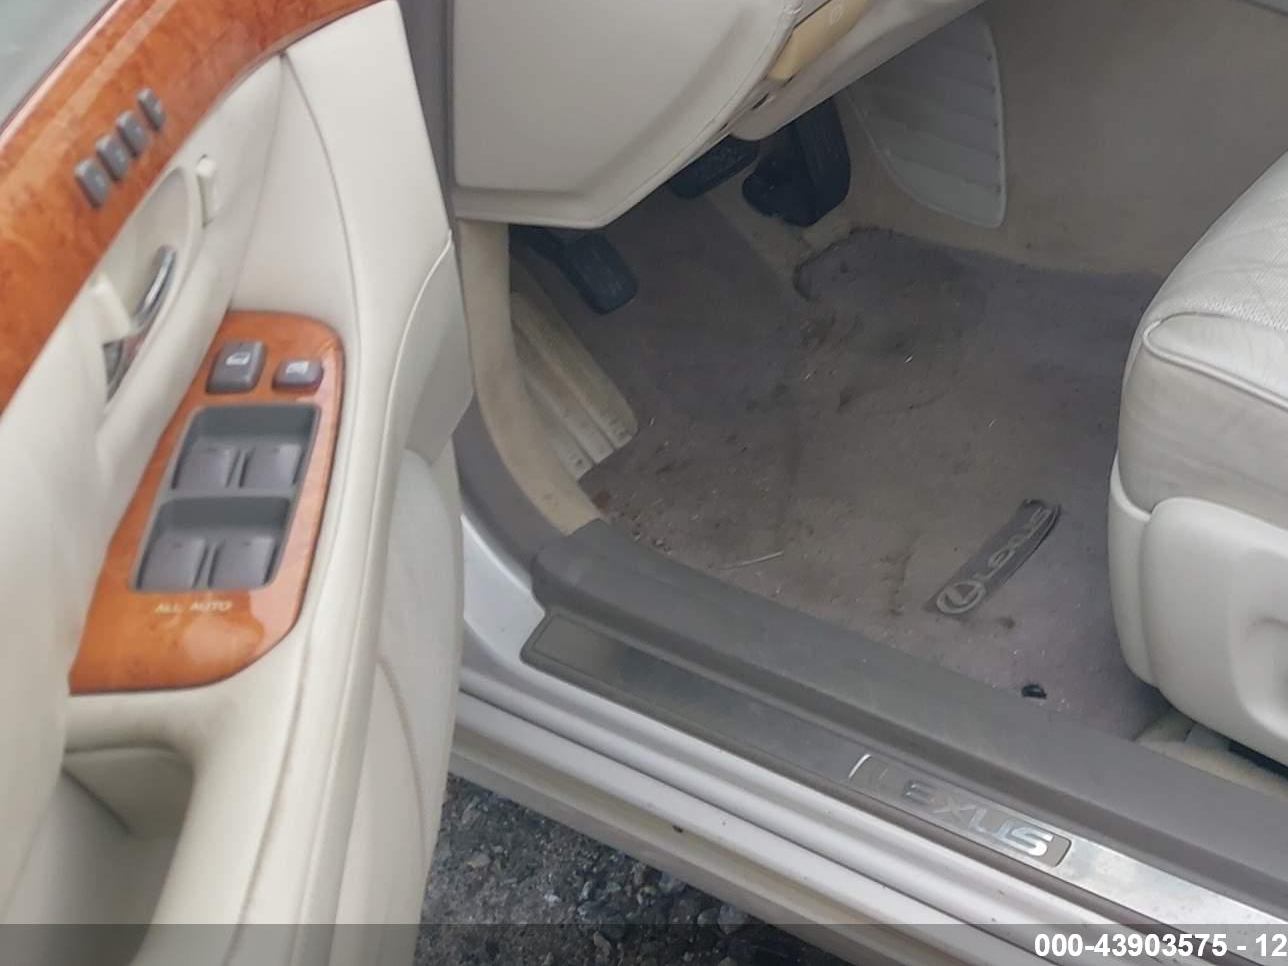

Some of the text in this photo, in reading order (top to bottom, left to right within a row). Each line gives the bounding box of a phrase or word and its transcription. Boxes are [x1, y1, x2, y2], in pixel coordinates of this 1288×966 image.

[154, 600, 233, 614] ALL AUTO
[872, 769, 1054, 857] EXUS
